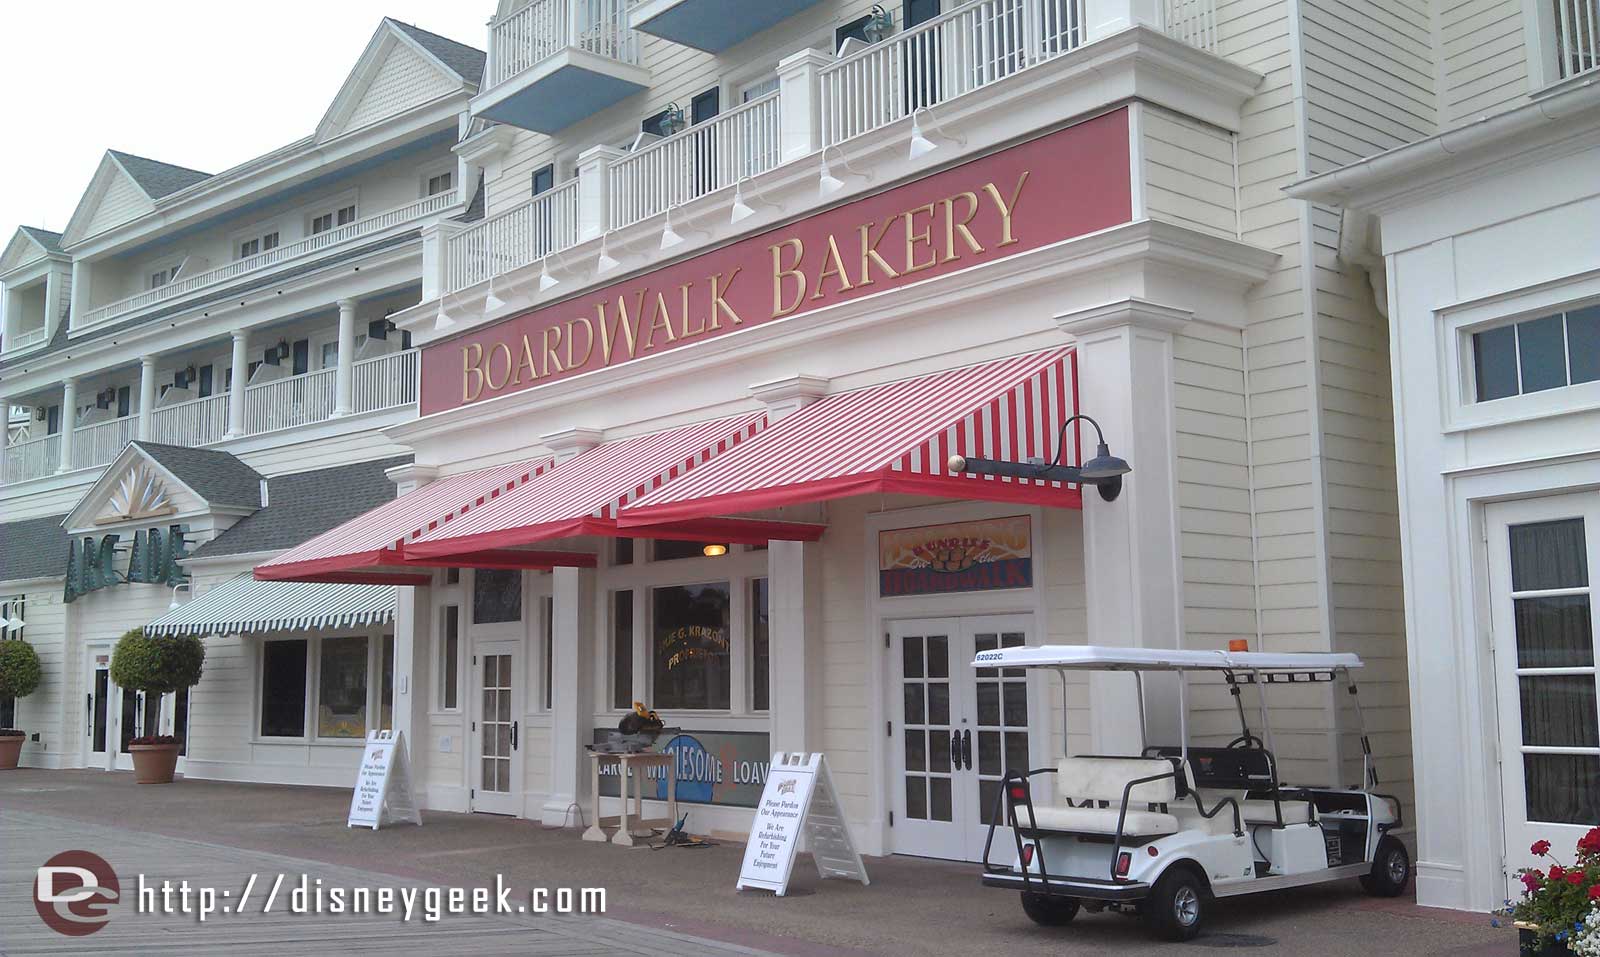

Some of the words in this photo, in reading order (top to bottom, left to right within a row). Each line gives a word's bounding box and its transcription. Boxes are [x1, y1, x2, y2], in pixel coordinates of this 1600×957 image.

[460, 267, 743, 405] BOARDWALK
[768, 171, 1031, 319] BAKERY
[781, 800, 799, 809] Pardon
[761, 808, 770, 816] Our
[770, 809, 799, 818] Appearance
[767, 822, 775, 830] We
[775, 823, 784, 831] Are
[758, 831, 787, 842] Refurbishing
[760, 840, 769, 848] For
[769, 841, 780, 850] Your
[760, 850, 776, 859] Future
[753, 859, 778, 869] Enjoyment
